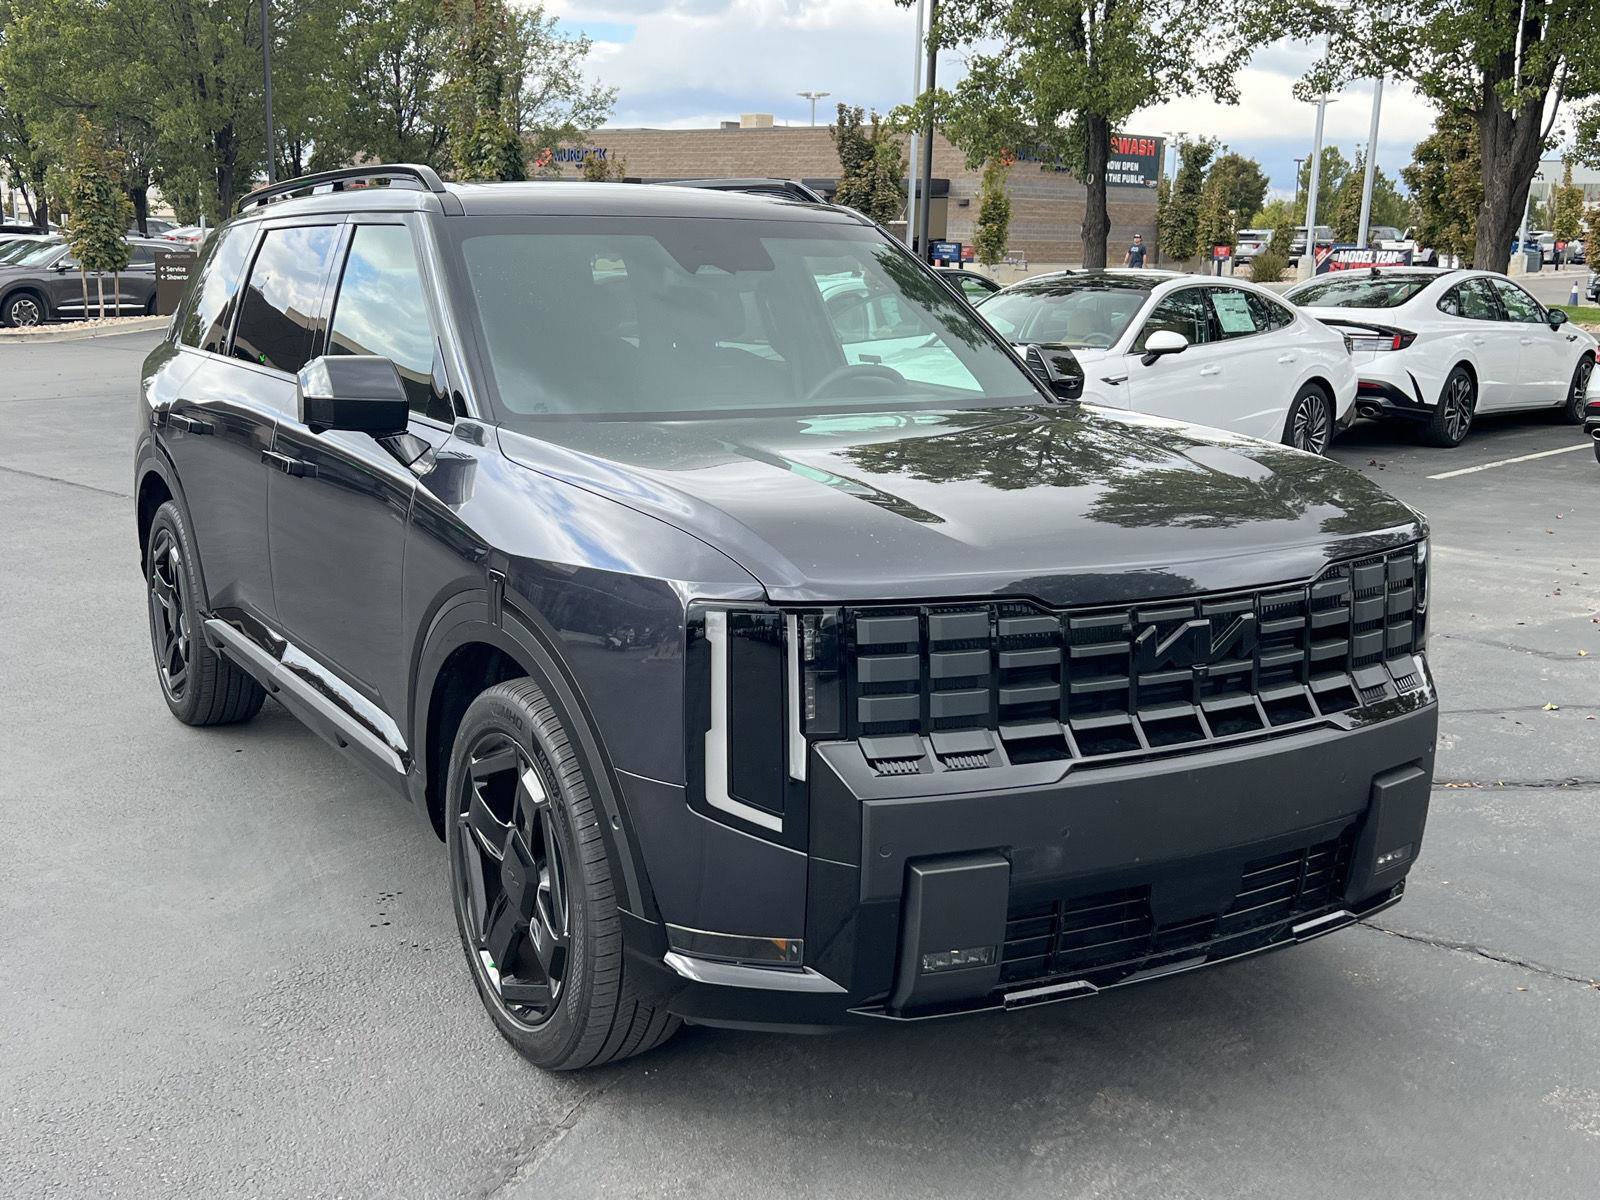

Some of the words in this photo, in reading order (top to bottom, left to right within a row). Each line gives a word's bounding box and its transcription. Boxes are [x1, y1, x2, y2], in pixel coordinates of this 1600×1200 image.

[1119, 137, 1155, 156] WASH
[1122, 161, 1139, 171] OPEN
[1109, 173, 1121, 183] THE
[1122, 174, 1144, 184] PUBLIC
[1338, 250, 1373, 263] MODEL
[1374, 250, 1399, 263] YEAR
